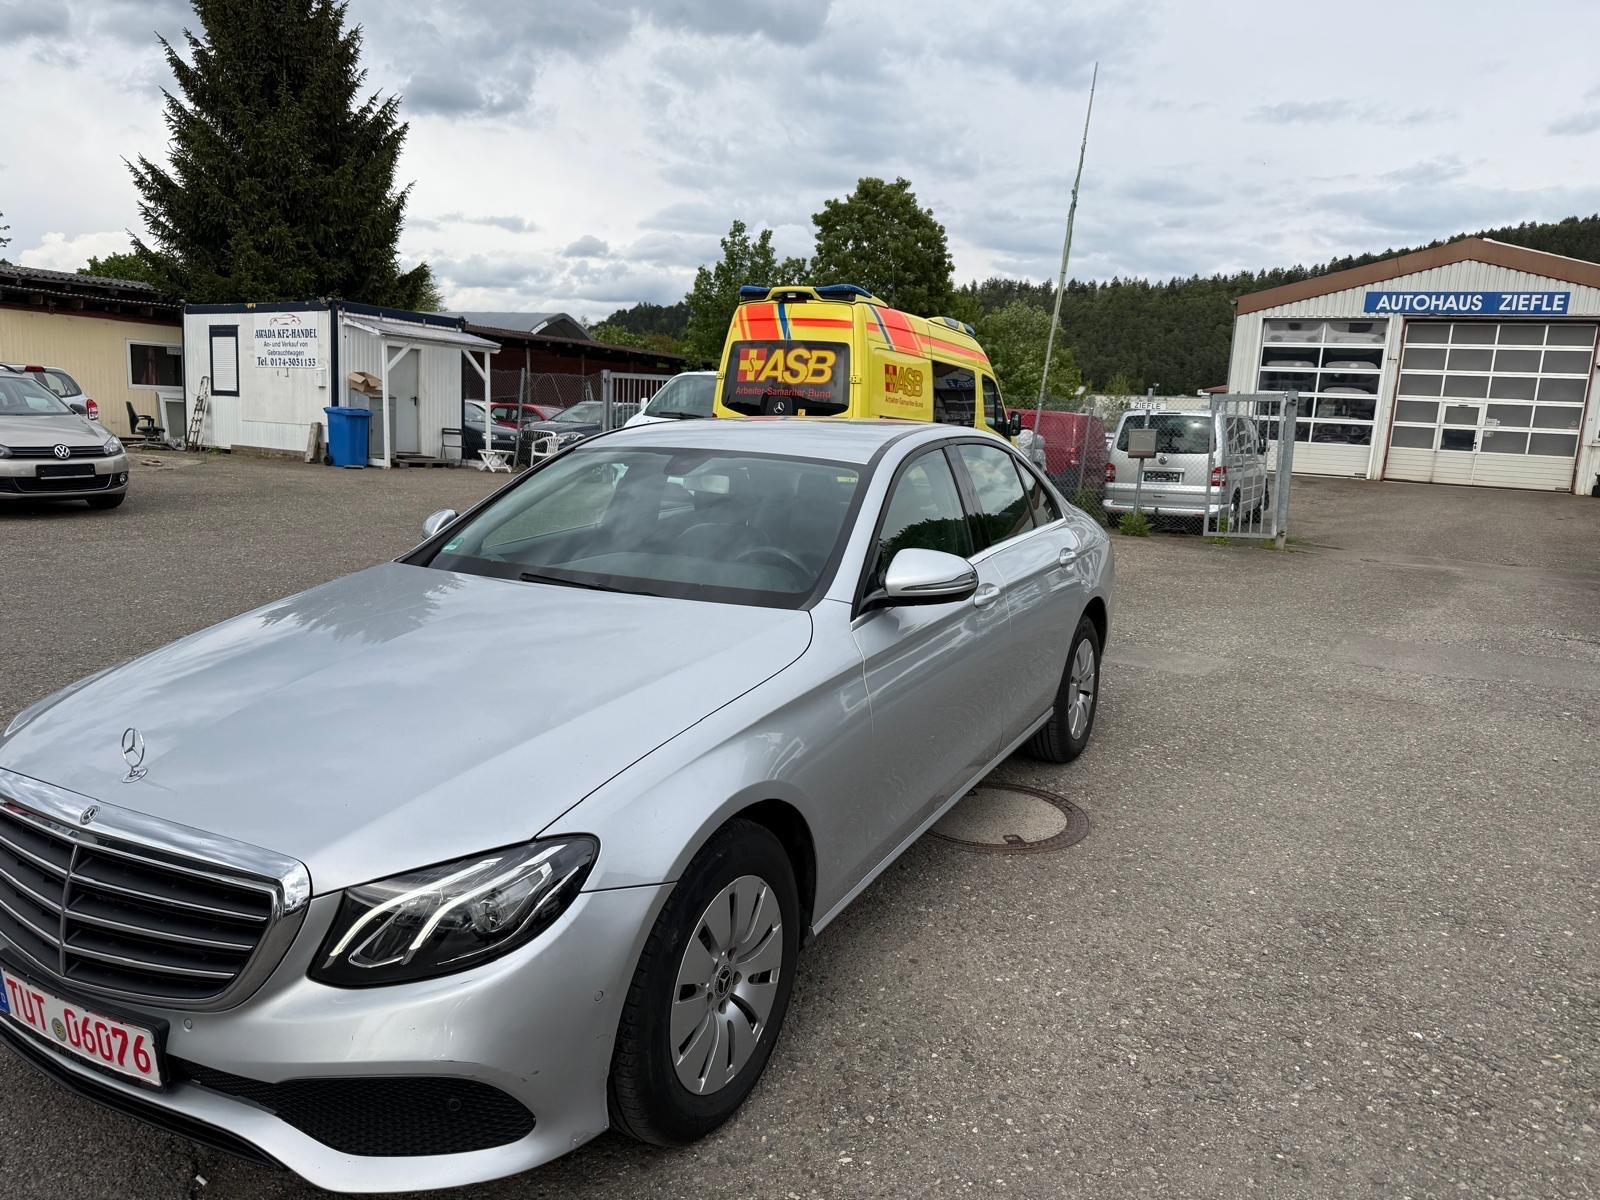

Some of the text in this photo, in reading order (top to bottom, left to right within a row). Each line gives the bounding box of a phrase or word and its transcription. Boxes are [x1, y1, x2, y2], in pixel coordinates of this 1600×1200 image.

[1376, 294, 1565, 311] AUTOHAUS ZIEFLE
[255, 328, 317, 339] AWADA KFZ-HANDEL
[257, 356, 269, 366] Tel.
[755, 347, 837, 385] ASB
[894, 366, 923, 398] ASB
[735, 385, 832, 399] Arbeiter-Samariter-Bund
[1134, 401, 1161, 410] ZIEFLE
[6, 977, 151, 1074] TUT 06076
